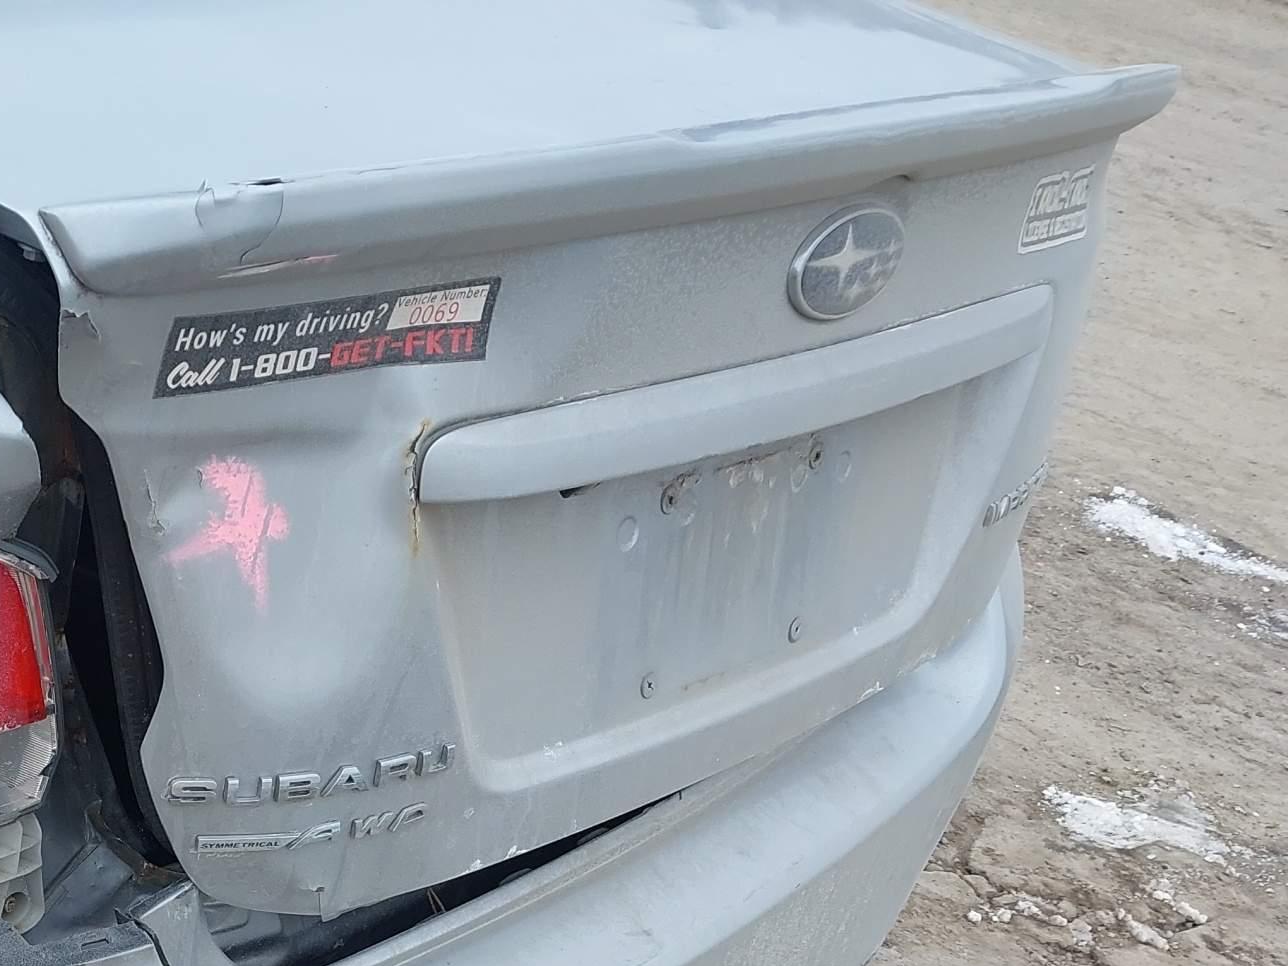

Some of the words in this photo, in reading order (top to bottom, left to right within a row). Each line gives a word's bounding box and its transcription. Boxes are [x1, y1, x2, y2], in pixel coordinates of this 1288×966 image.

[397, 292, 438, 308] Vehicle
[408, 301, 460, 325] 0069
[174, 322, 248, 352] How's
[253, 321, 290, 347] my
[295, 303, 389, 337] driving?
[166, 357, 226, 390] Call
[166, 743, 456, 806] SUBARU
[199, 841, 281, 850] SYMMETRICAL
